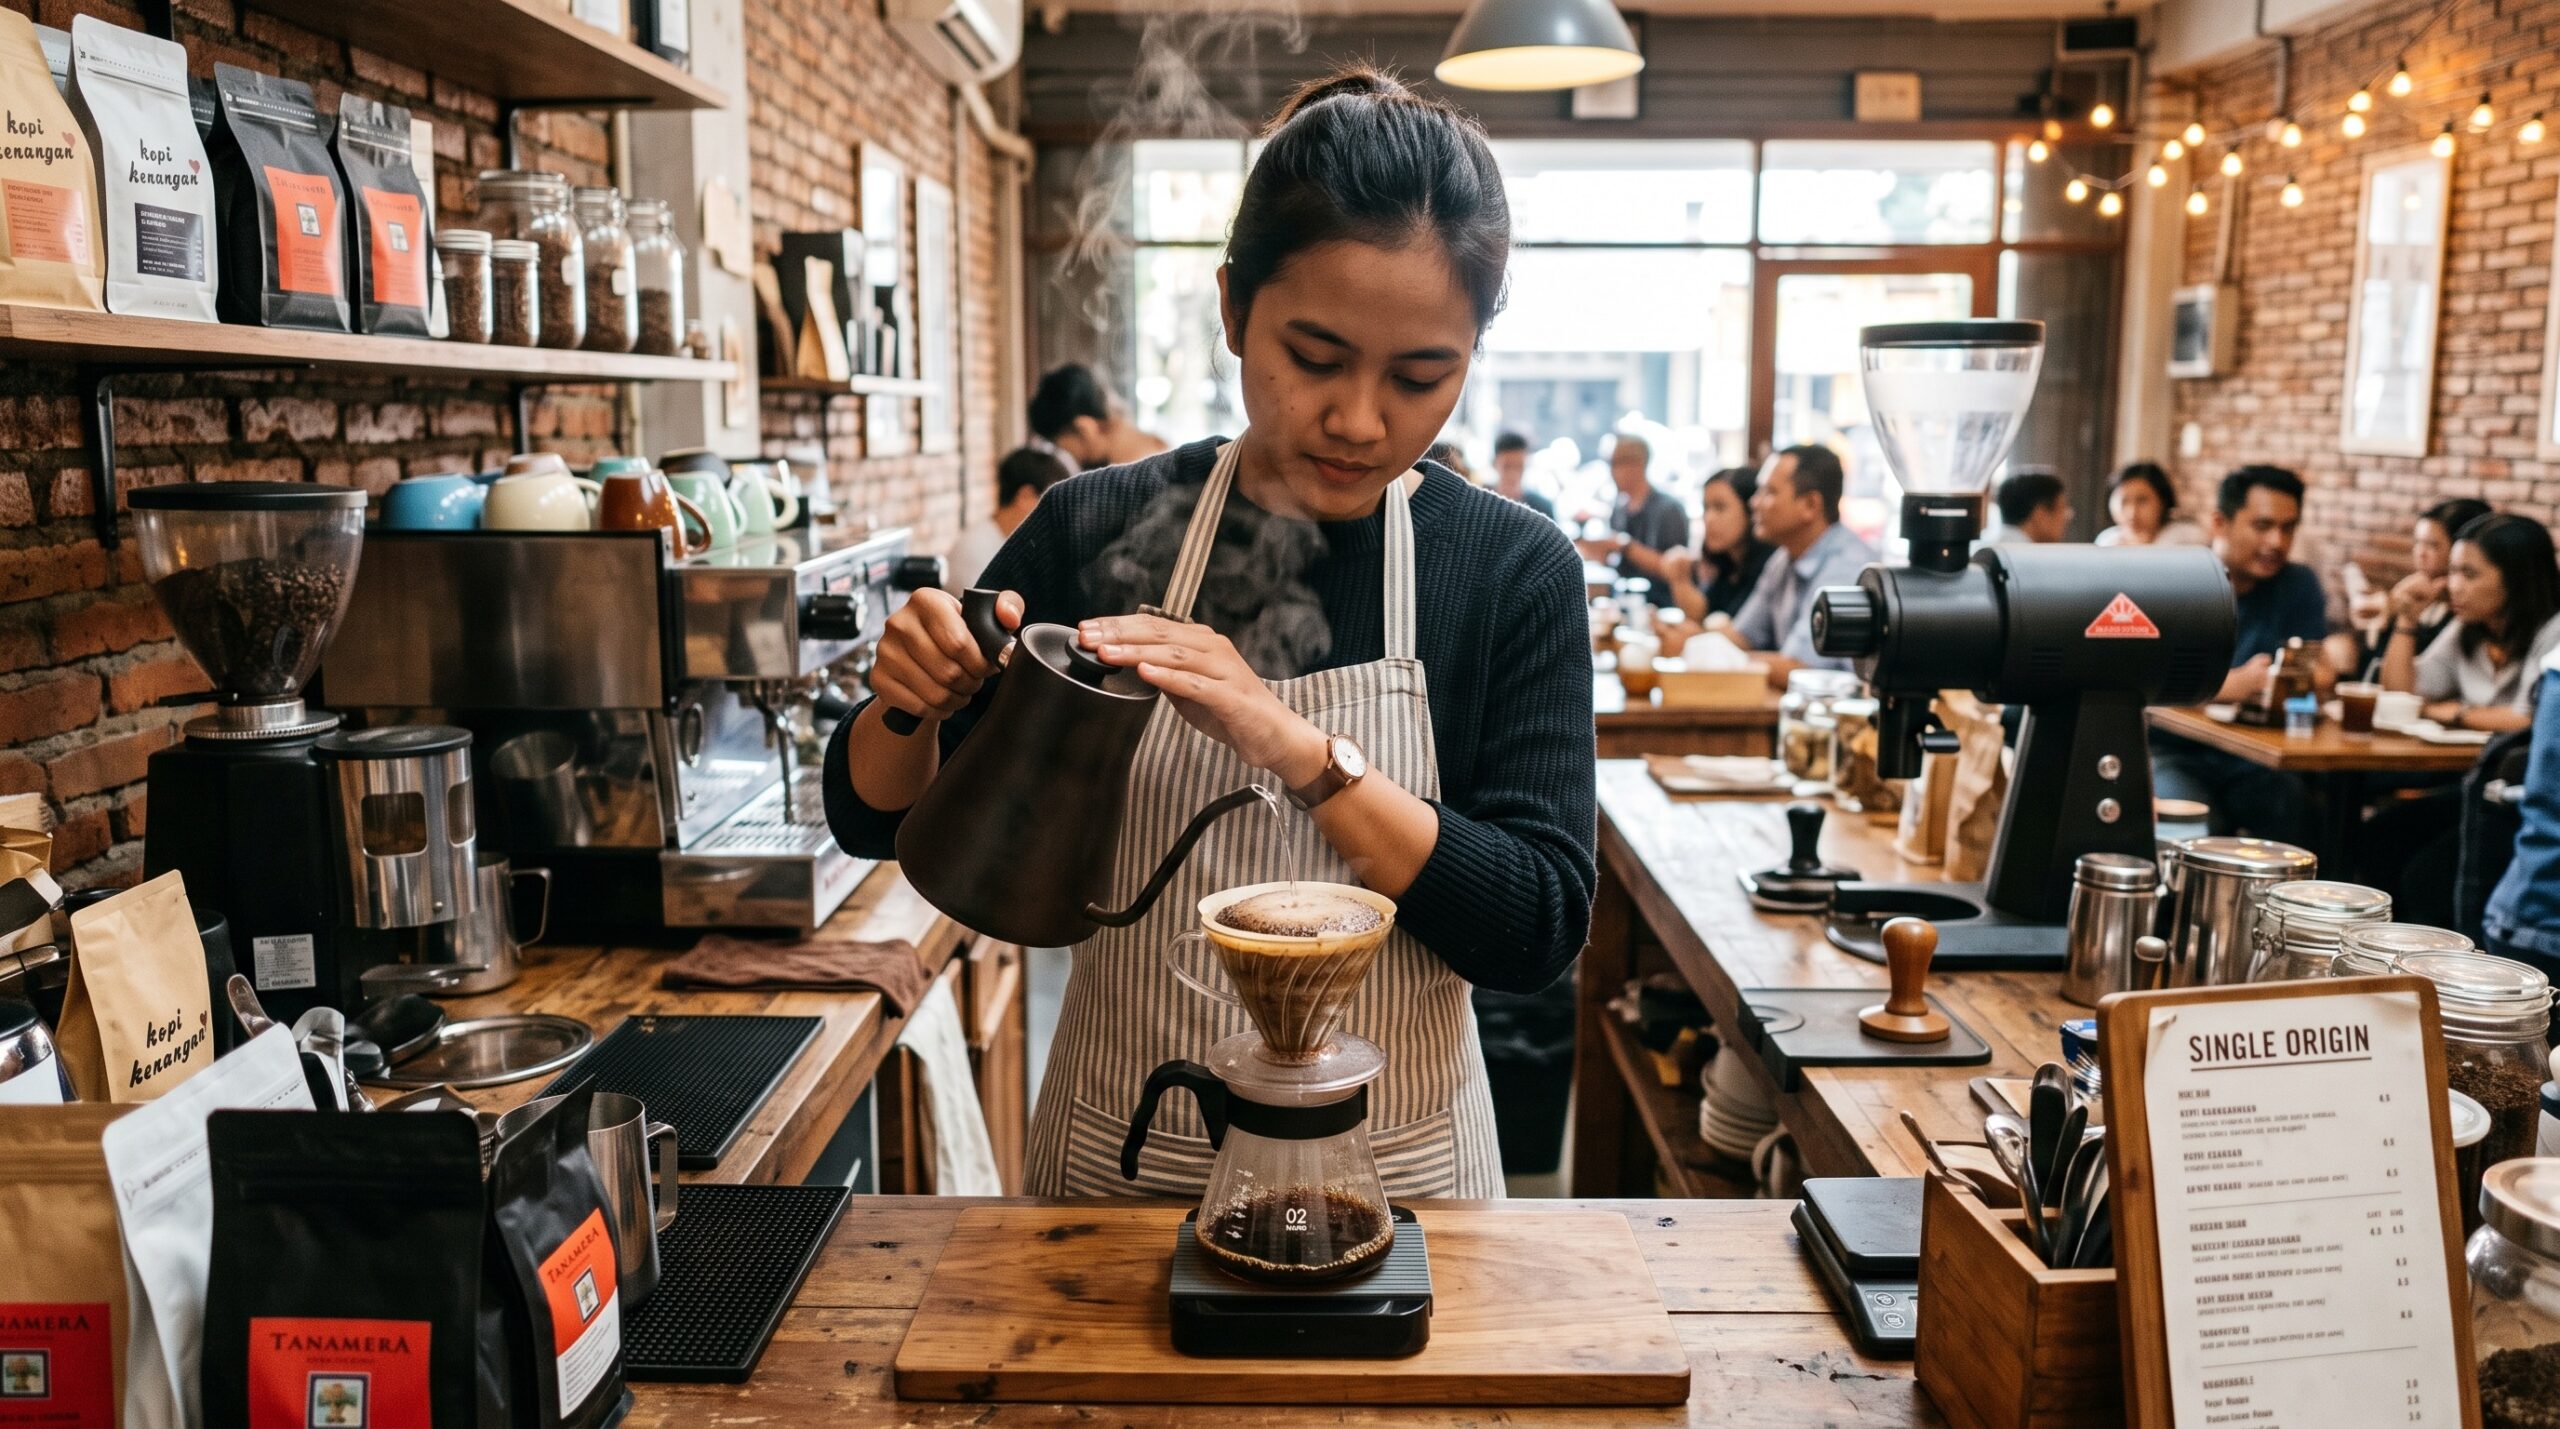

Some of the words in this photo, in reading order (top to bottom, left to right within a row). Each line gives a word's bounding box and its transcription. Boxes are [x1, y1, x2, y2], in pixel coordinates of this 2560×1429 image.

[7, 110, 44, 138] kopi
[140, 138, 172, 165] kopi
[129, 160, 199, 191] kenangan
[146, 1008, 182, 1048] kopi
[129, 1027, 205, 1088] kenangan
[2189, 1031, 2277, 1063] SINGLE
[2285, 1024, 2370, 1057] ORIGIN
[1286, 1208, 1307, 1224] 02
[0, 1314, 90, 1331] AMERA
[269, 1332, 411, 1354] TANAMERA
